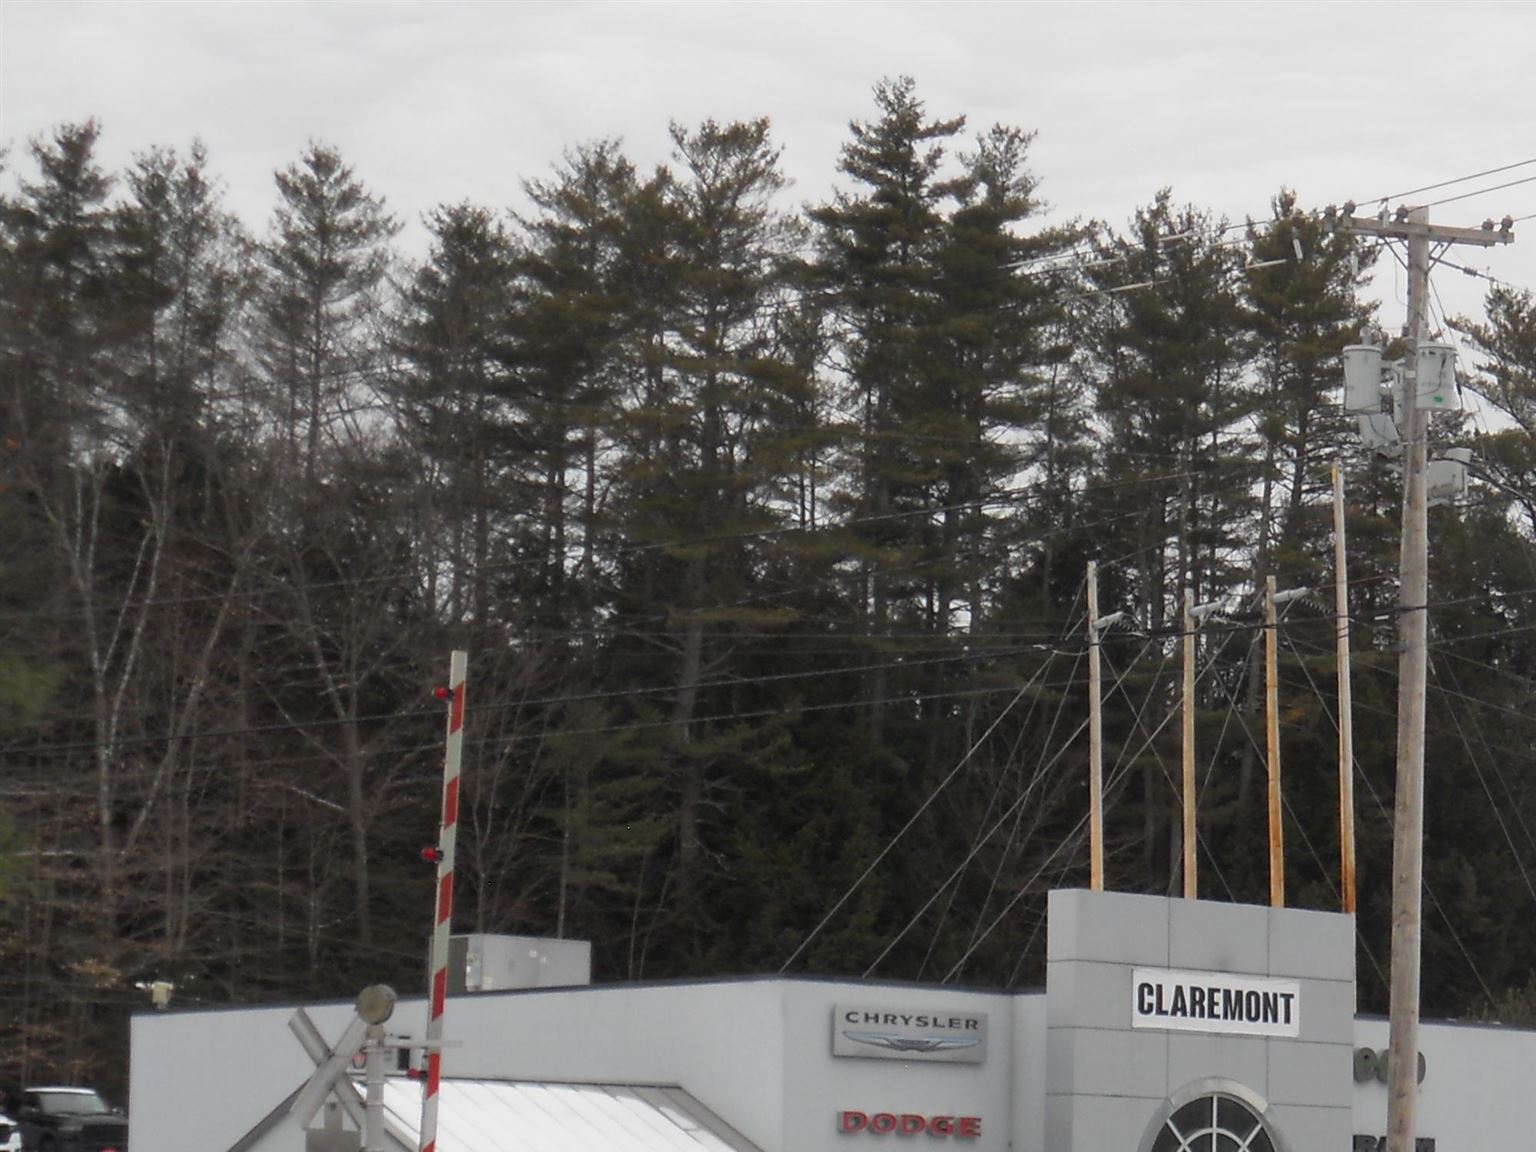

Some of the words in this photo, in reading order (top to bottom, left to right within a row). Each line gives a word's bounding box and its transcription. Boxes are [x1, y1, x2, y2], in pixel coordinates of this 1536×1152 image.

[1137, 982, 1295, 1025] CLAREMONT
[845, 1011, 979, 1030] CHRYSLER
[839, 1110, 982, 1137] DODGE
